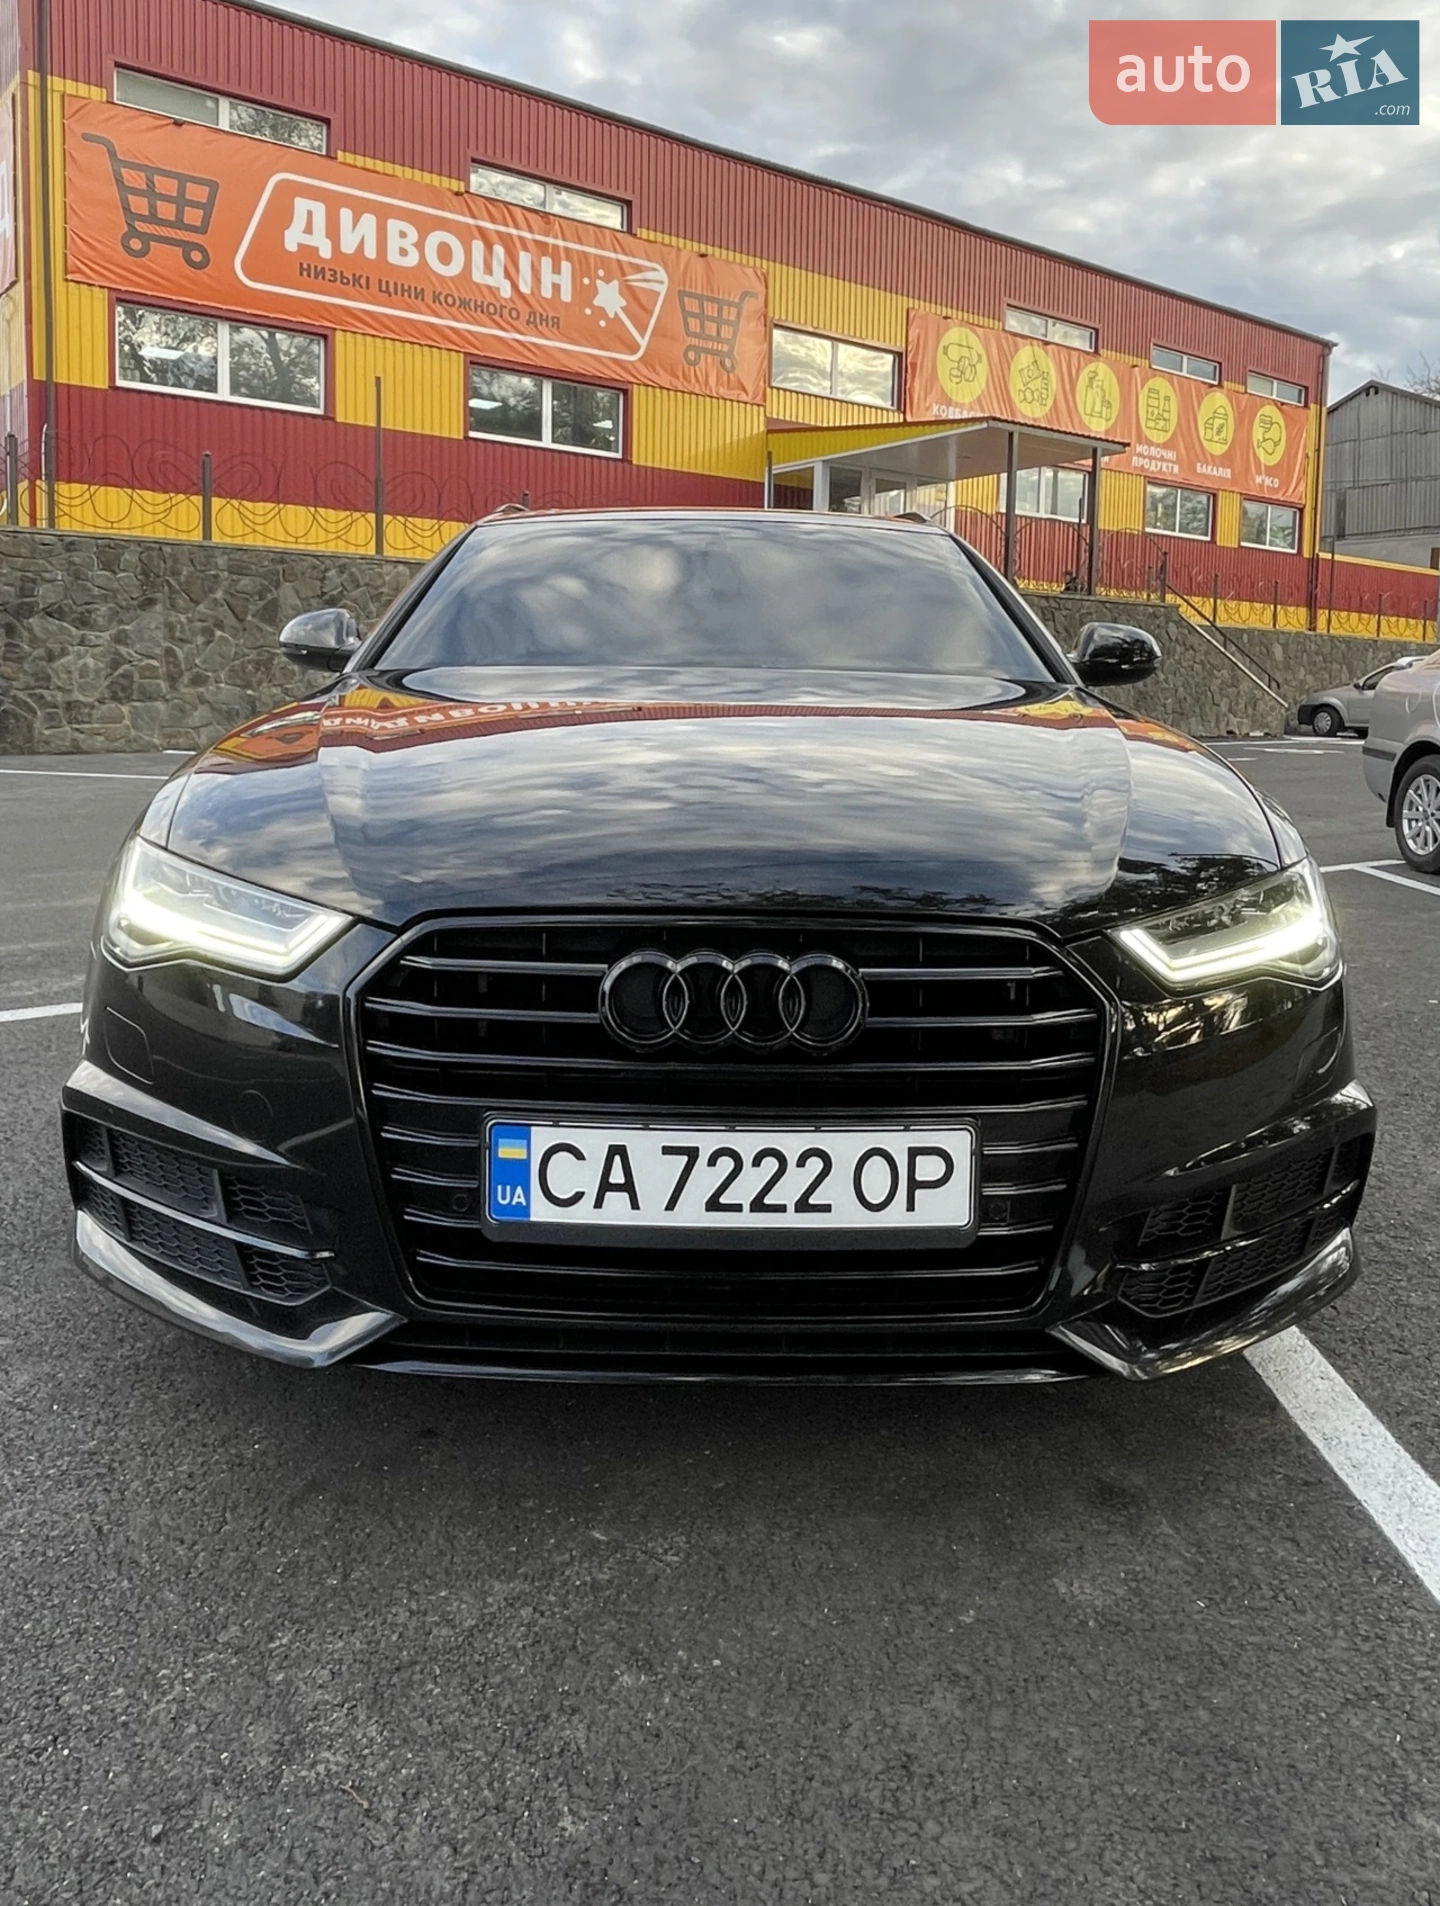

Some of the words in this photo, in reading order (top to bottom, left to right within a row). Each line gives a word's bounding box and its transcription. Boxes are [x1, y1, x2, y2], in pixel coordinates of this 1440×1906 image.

[284, 197, 572, 302] ДИВОЦІН
[298, 262, 370, 290] НИЗЬКІ
[377, 278, 425, 302] ЦІНИ
[432, 292, 521, 322] КОЖНОГО
[526, 310, 560, 329] ДНЯ
[1135, 443, 1177, 461] МОЛОЧНІ
[1132, 456, 1179, 474] ПРОДУКТИ
[1196, 462, 1231, 479] БАКАЛІЯ
[537, 1142, 641, 1212] CA
[661, 1145, 833, 1214] 7222
[852, 1145, 955, 1213] OP
[497, 1185, 527, 1206] UA
